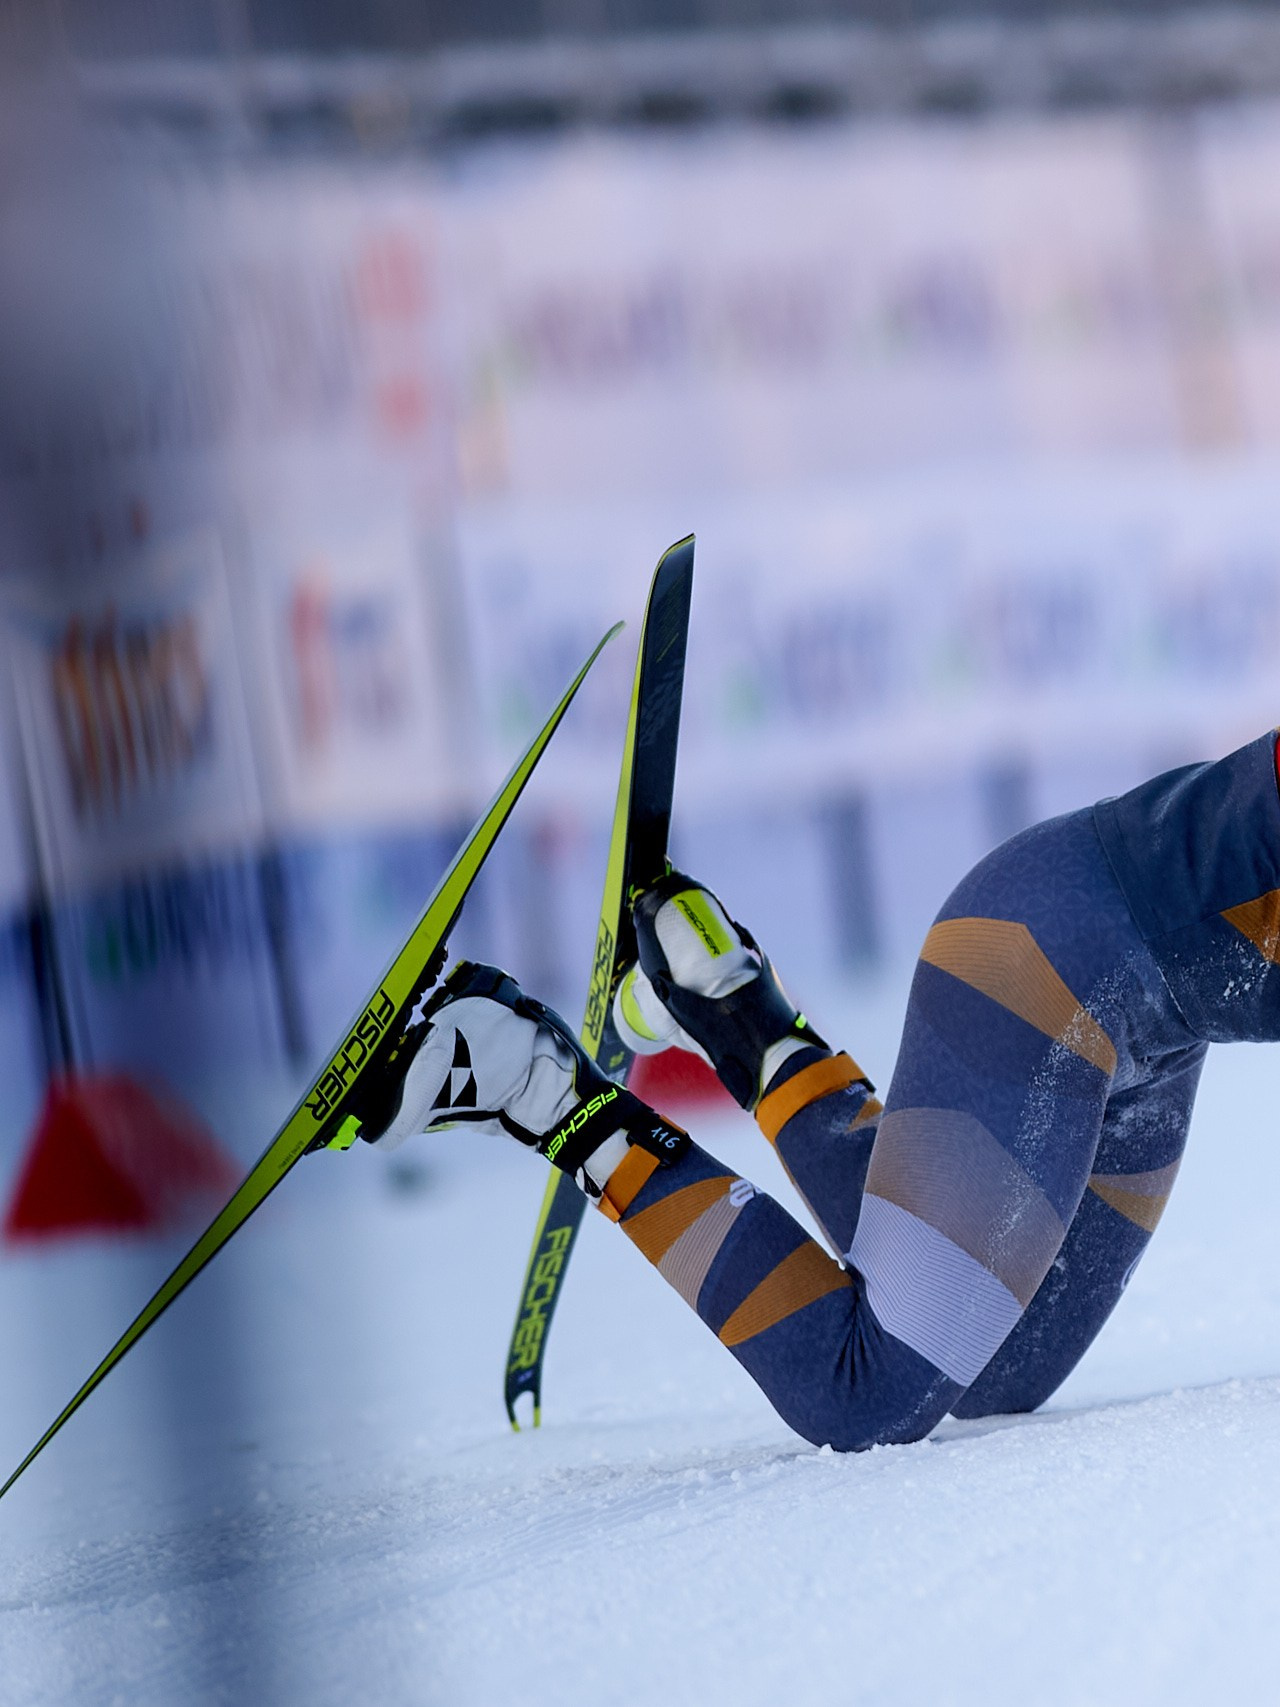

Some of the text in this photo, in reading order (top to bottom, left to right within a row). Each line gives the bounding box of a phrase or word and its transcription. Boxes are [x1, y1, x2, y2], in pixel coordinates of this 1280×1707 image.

[677, 899, 721, 957] FISCHER
[585, 918, 614, 1041] FISCHER
[305, 989, 396, 1121] FISCHER
[544, 1087, 619, 1162] FISCHER
[650, 1127, 681, 1149] 116
[509, 1226, 573, 1373] FISCHER
